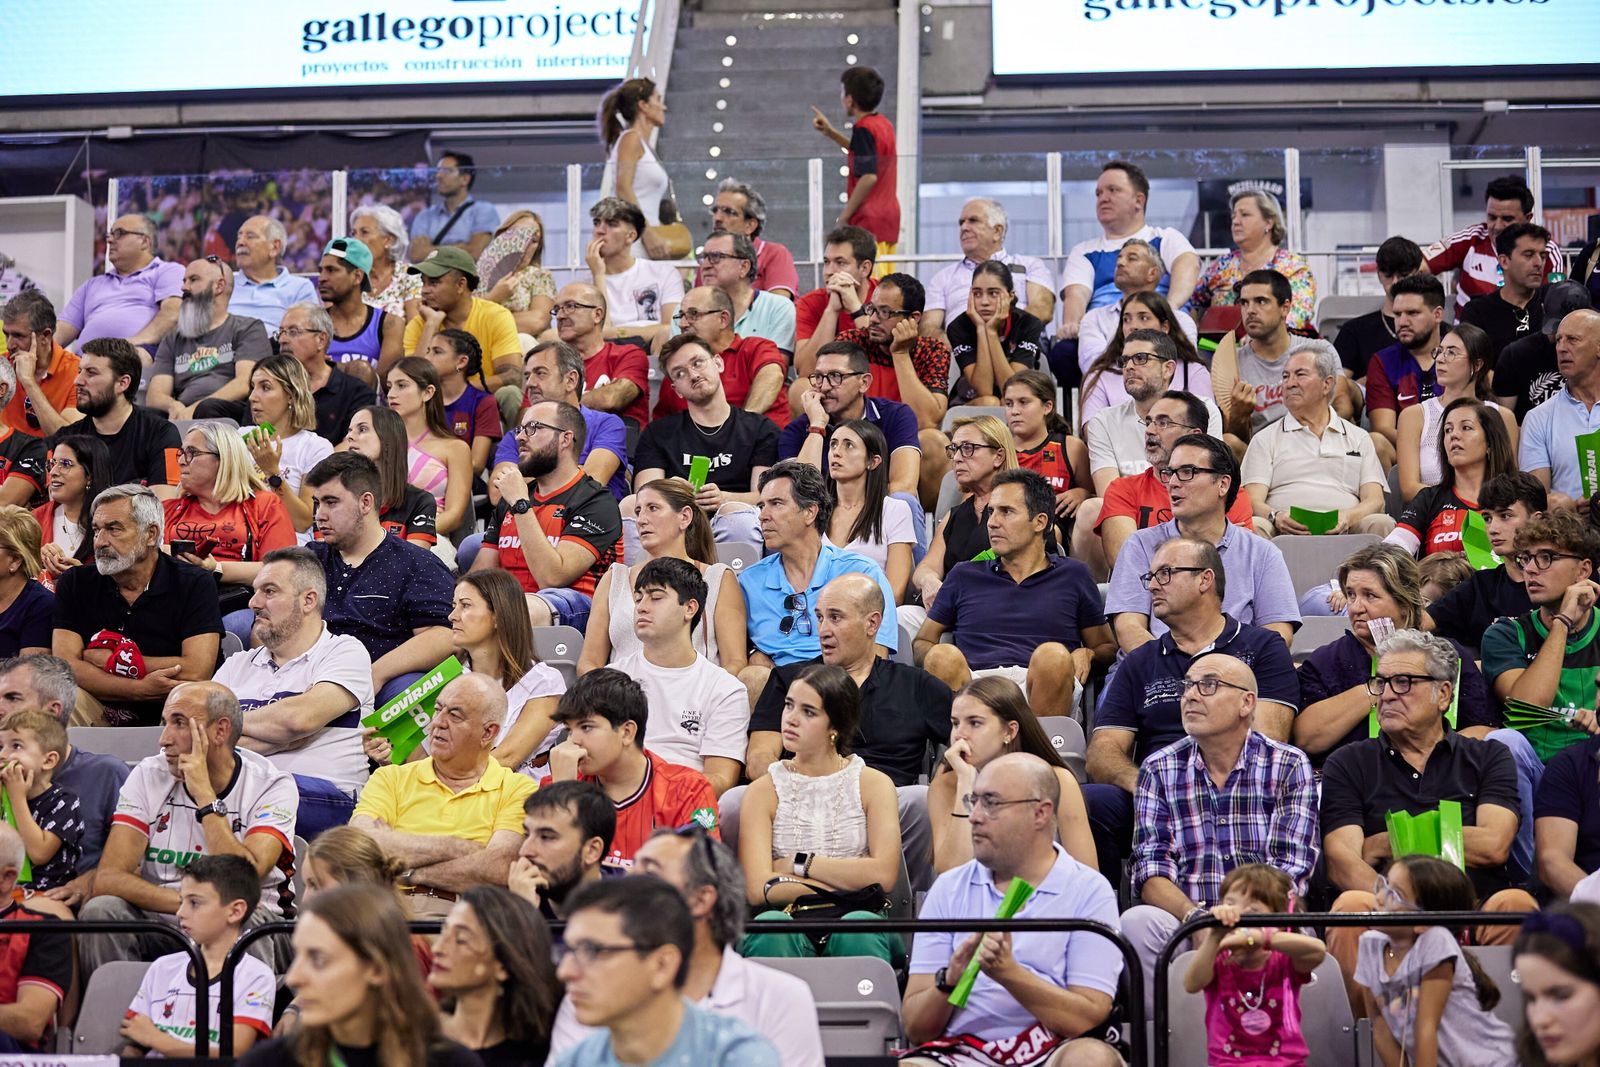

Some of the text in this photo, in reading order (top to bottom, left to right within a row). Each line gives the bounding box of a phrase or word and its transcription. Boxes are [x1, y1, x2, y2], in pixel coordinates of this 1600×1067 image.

[302, 6, 648, 53] gallegoprojects
[302, 60, 389, 77] proyectos
[404, 54, 522, 72] construcción
